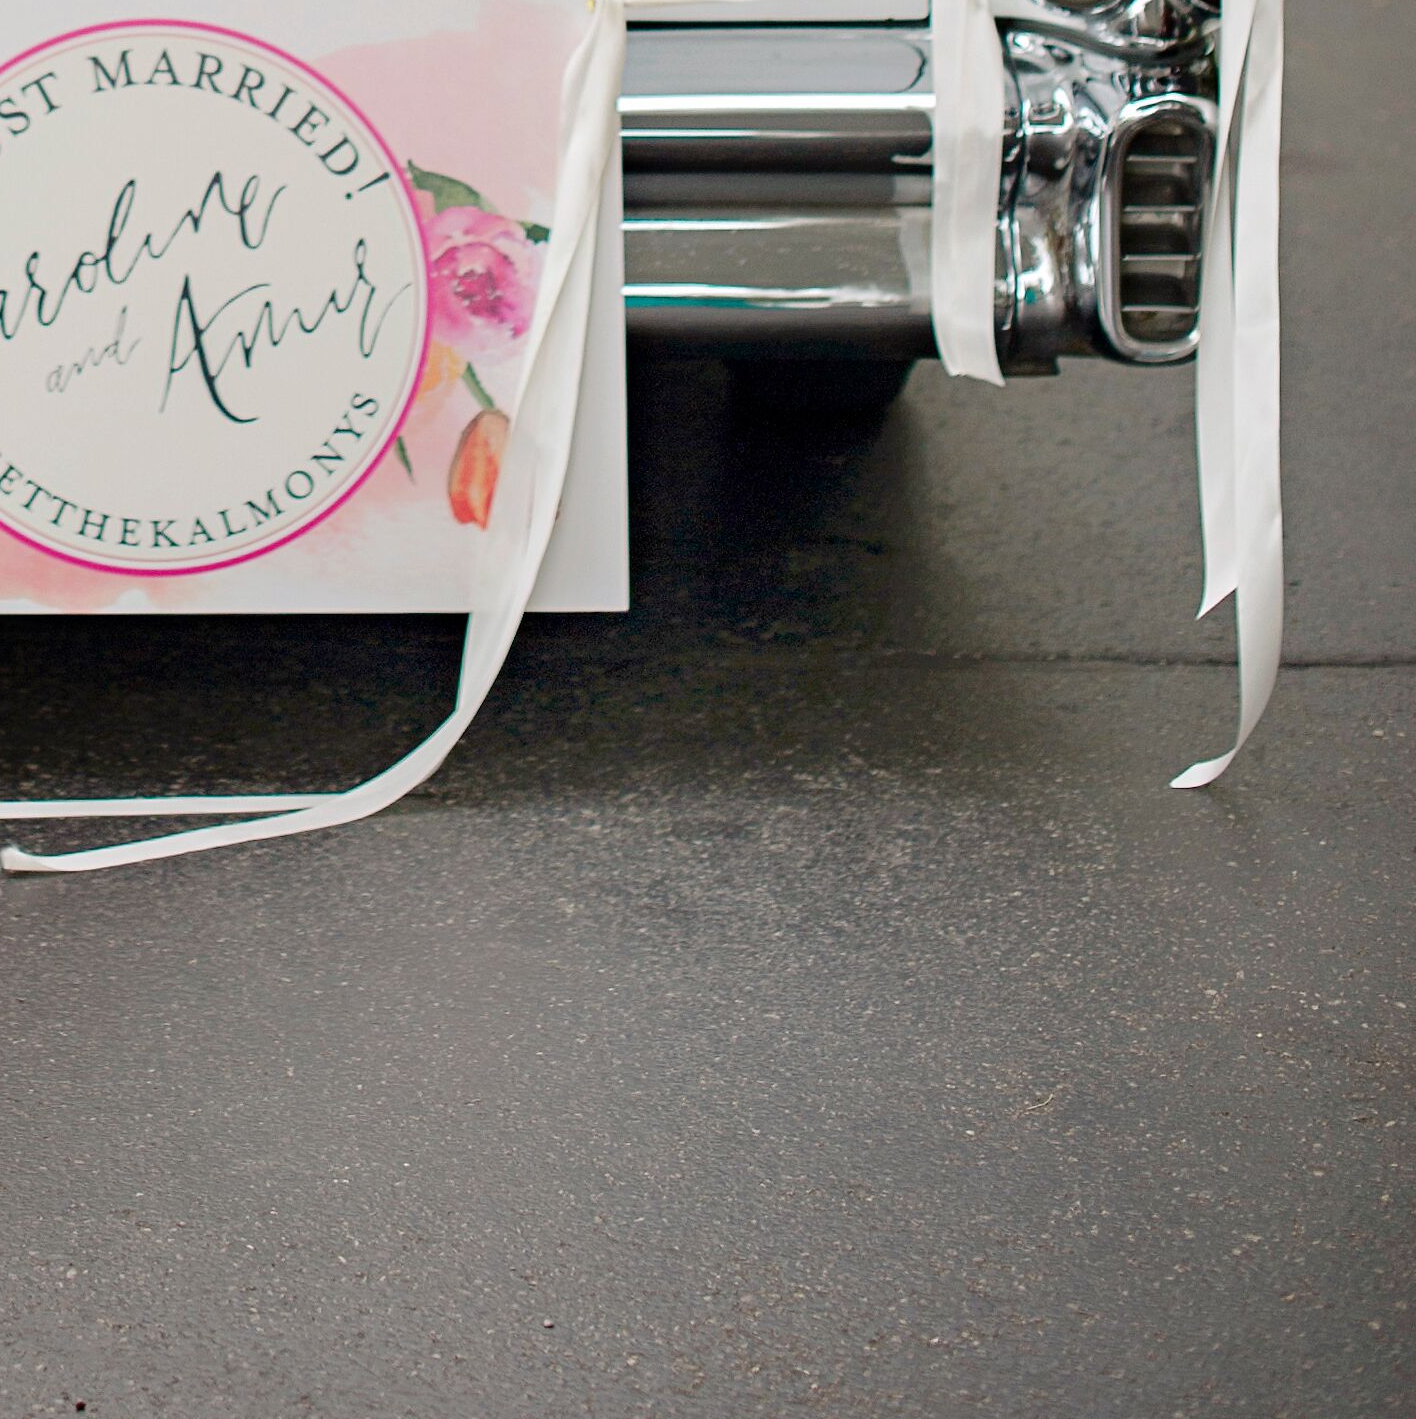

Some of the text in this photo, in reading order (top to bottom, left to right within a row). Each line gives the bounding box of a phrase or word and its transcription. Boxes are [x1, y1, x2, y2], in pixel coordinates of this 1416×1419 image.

[85, 48, 391, 201] MARRIED!
[45, 237, 414, 424] and Amir
